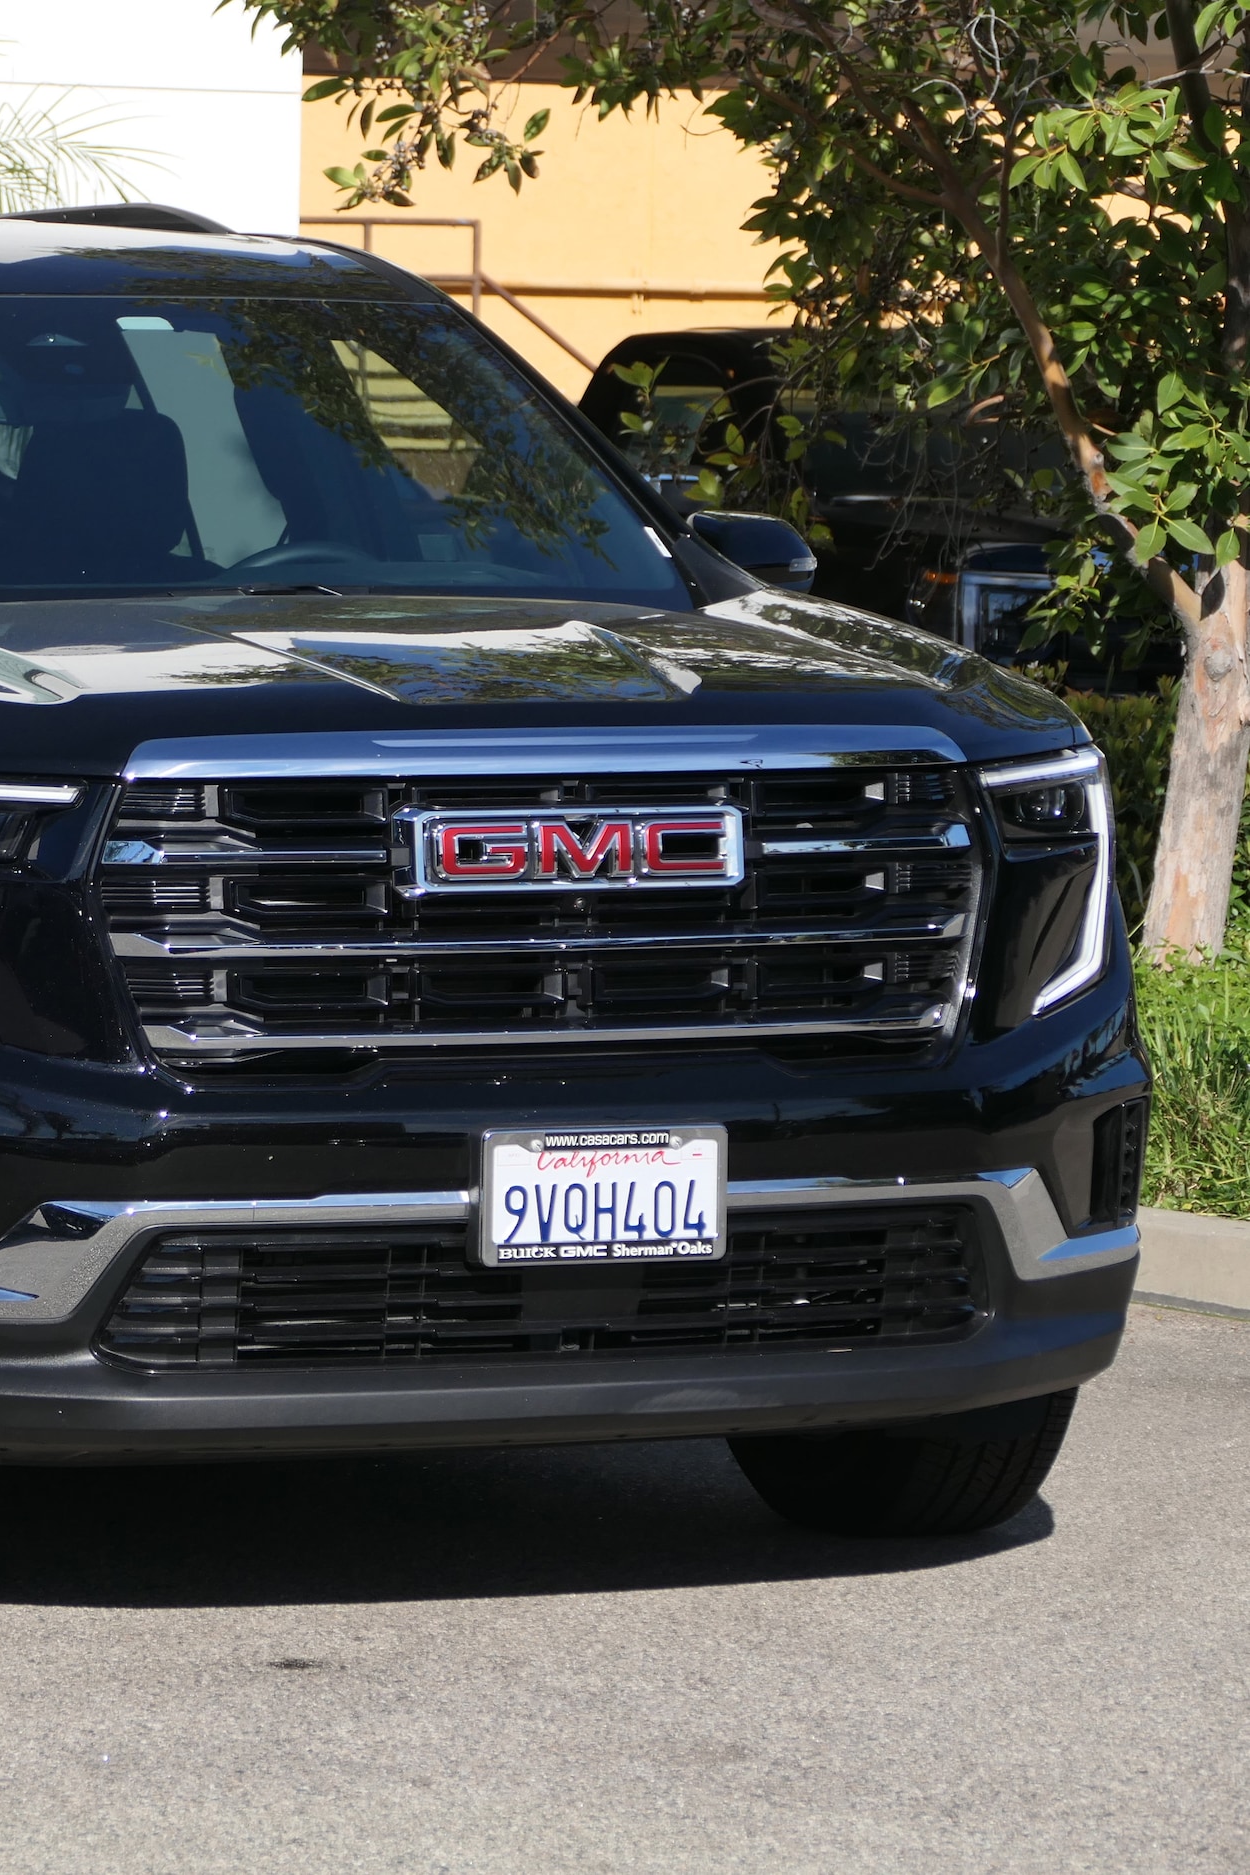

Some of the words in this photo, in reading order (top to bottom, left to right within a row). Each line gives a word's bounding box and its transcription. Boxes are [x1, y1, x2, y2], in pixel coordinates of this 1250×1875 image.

[437, 819, 727, 880] GMC
[545, 1131, 669, 1148] www.casacars.com
[537, 1150, 681, 1178] California
[504, 1179, 706, 1243] 9VQH404
[499, 1245, 557, 1260] BUICK
[560, 1245, 607, 1258] GMC
[612, 1242, 672, 1259] Sherman
[678, 1241, 712, 1256] Oaks
